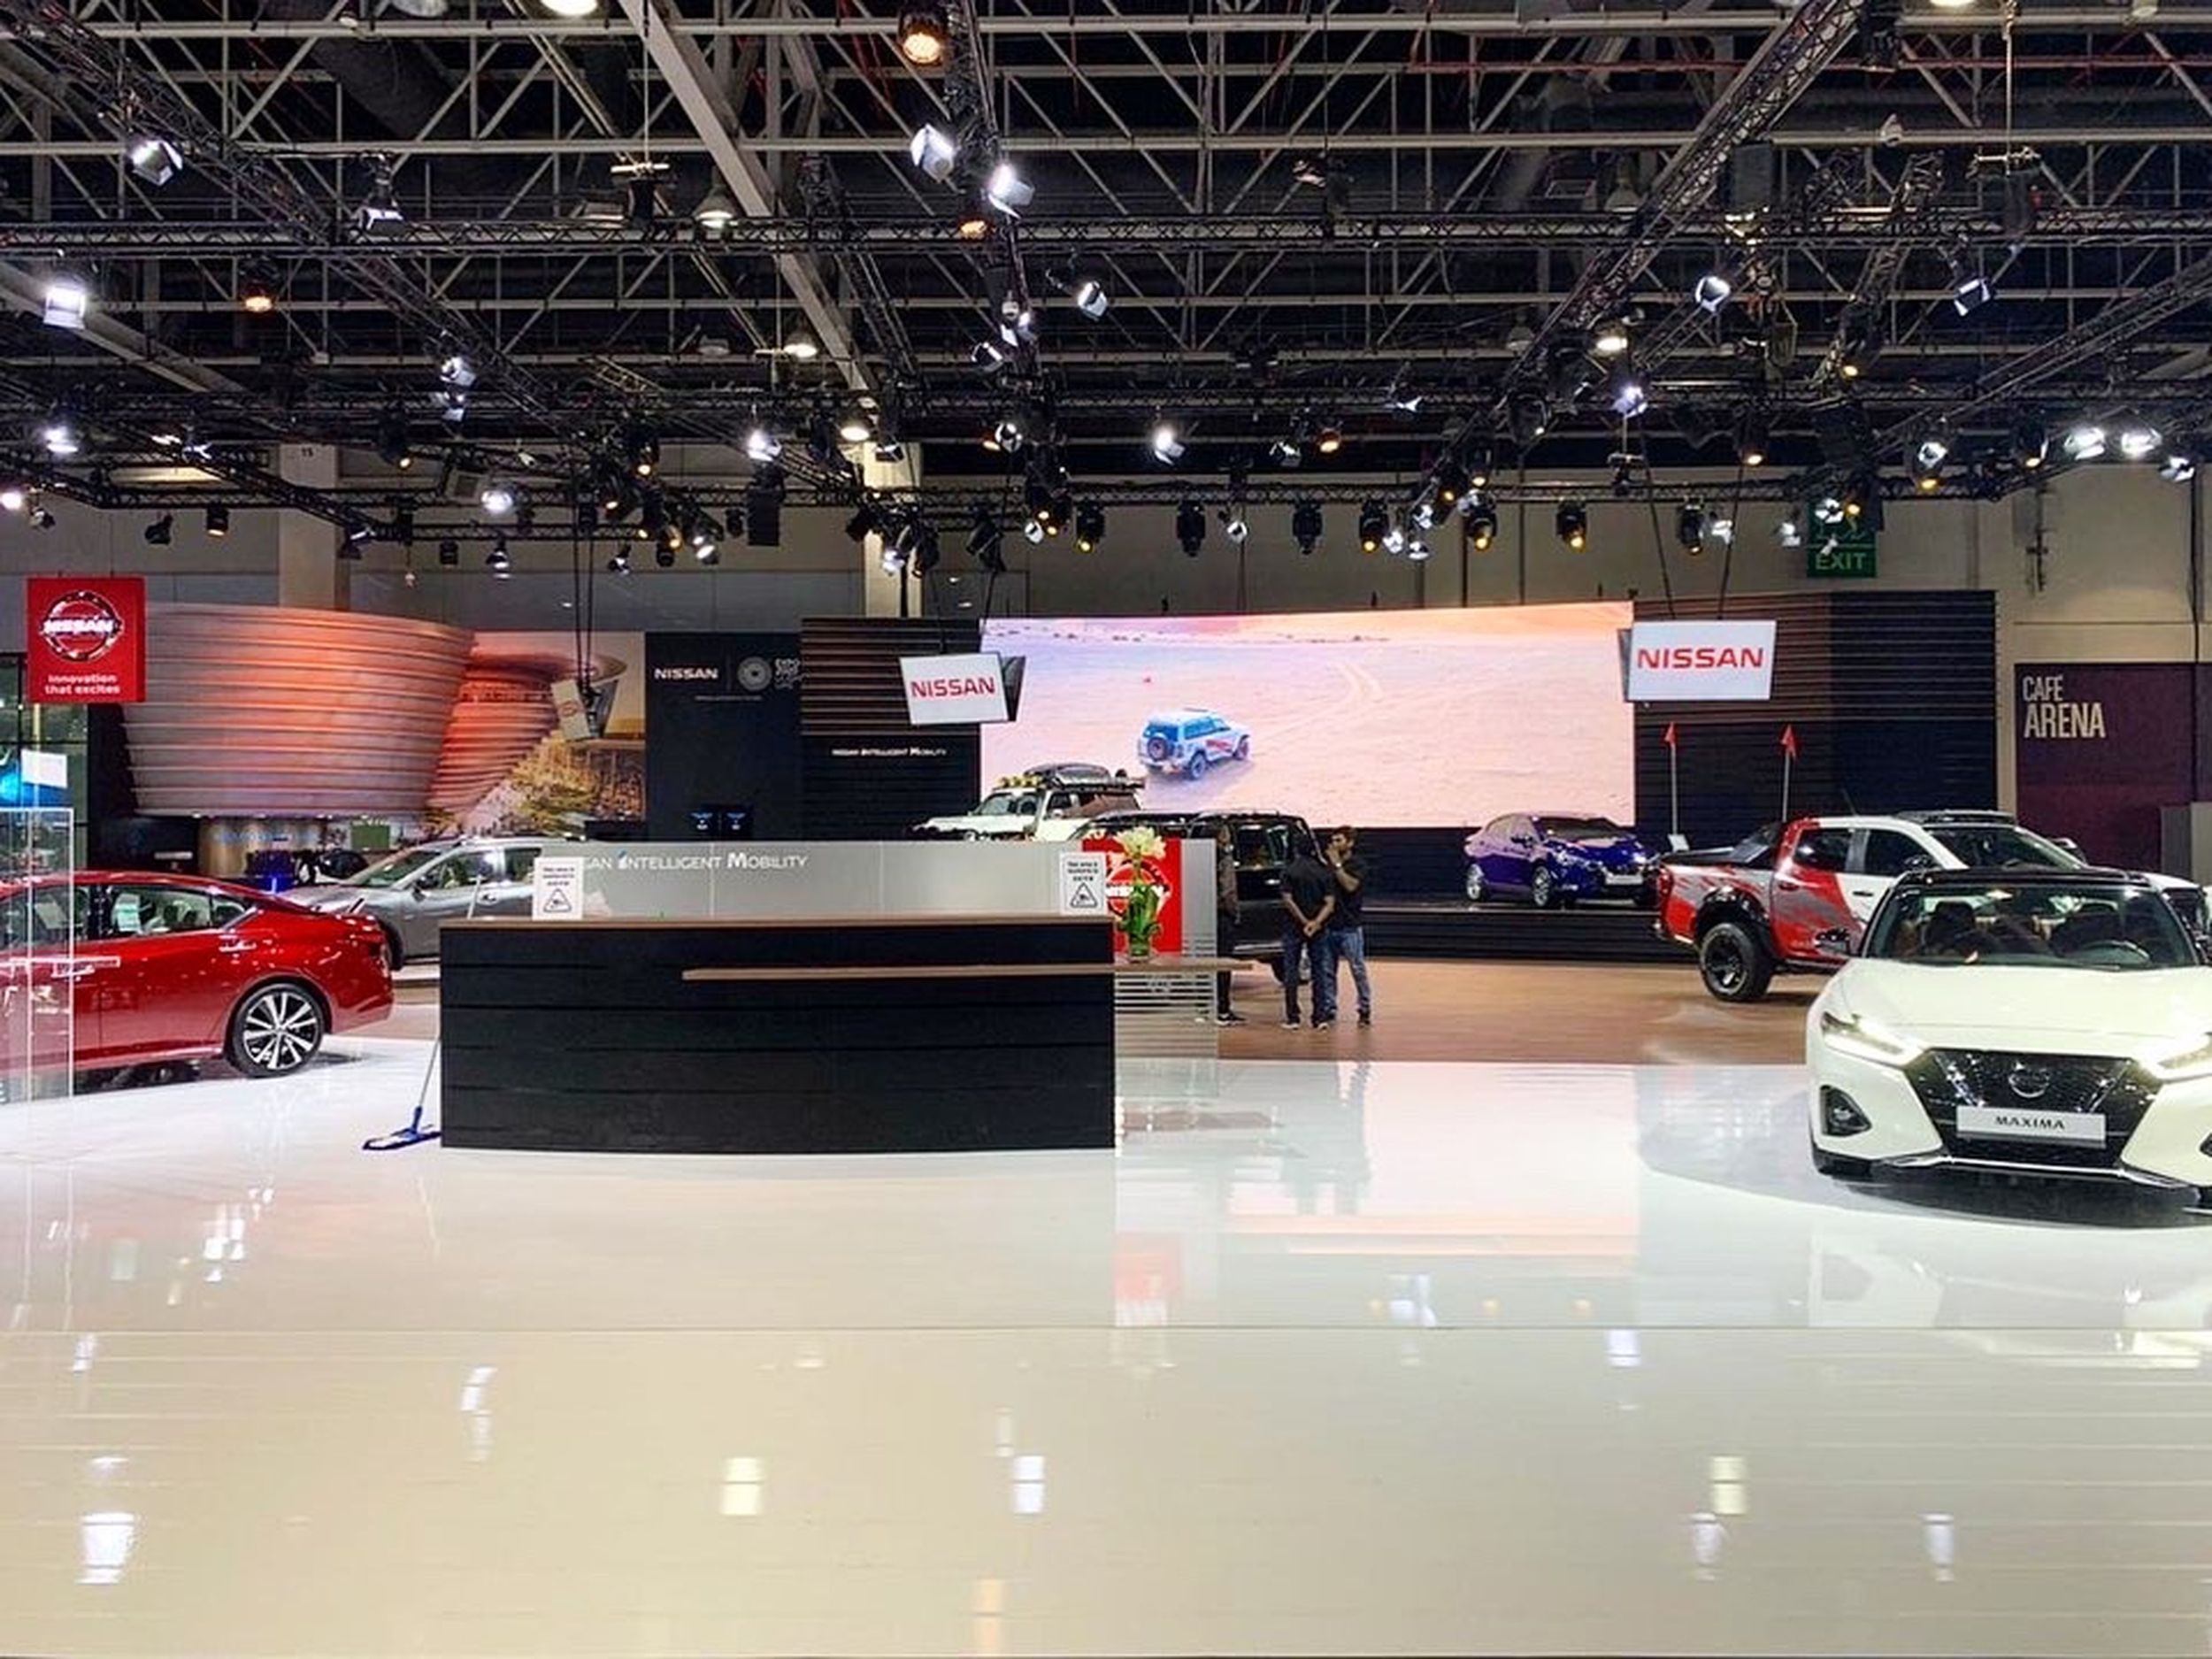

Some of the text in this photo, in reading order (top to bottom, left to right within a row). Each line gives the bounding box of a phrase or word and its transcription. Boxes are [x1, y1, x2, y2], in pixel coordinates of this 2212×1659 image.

[1816, 551, 1866, 570] EXIT
[1638, 648, 1763, 668] NISSAN
[654, 668, 718, 679] NISSAN
[910, 677, 995, 697] NISSAN
[2024, 703, 2106, 738] ARENA
[618, 850, 722, 869] INTELLIGENT
[727, 852, 809, 869] MOBILITY
[1996, 1116, 2065, 1130] MAXIMA
